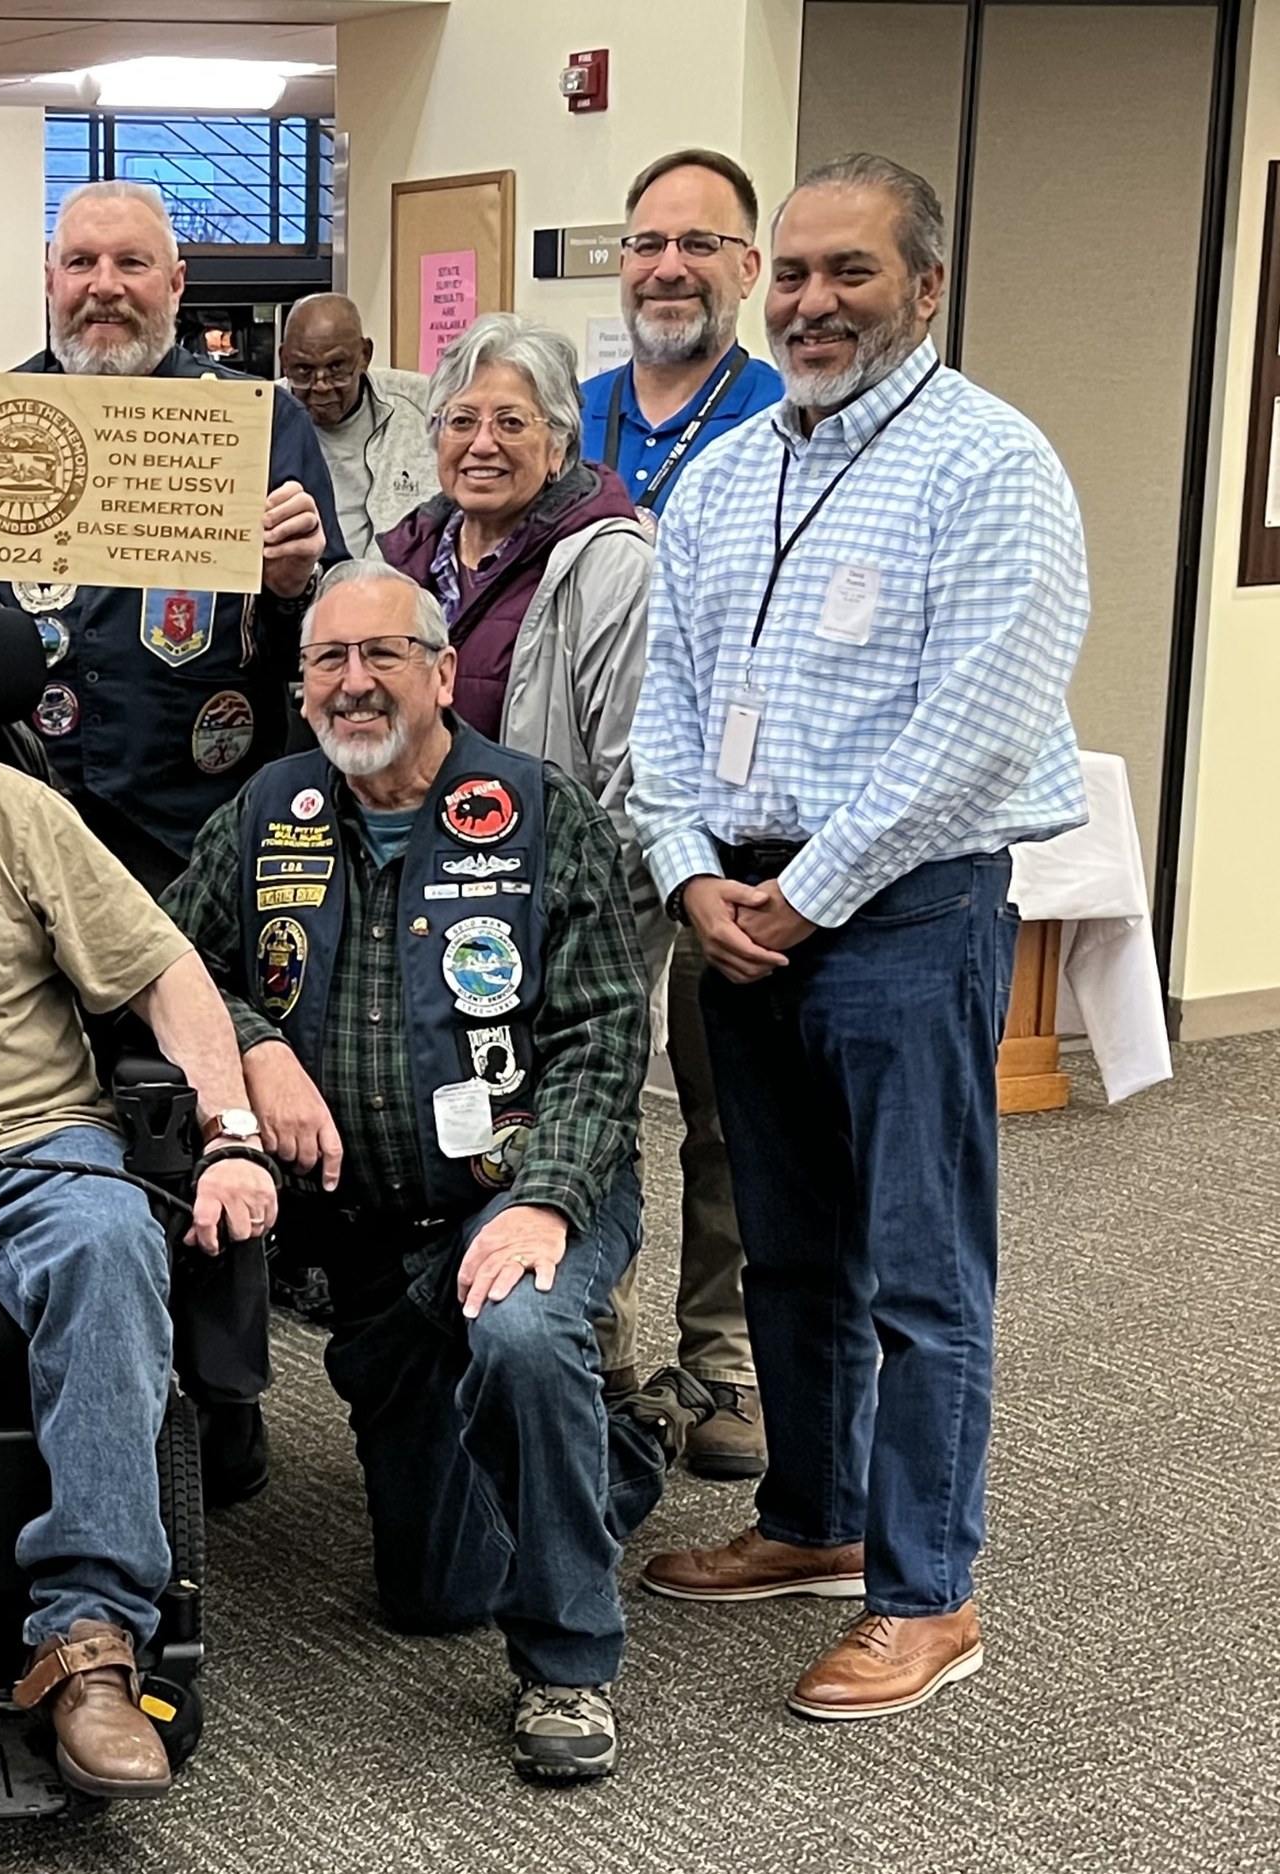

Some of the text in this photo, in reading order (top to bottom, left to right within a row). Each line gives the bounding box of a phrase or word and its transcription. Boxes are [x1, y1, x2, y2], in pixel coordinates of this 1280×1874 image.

[588, 249, 609, 265] 199
[438, 266, 460, 277] STATE
[433, 293, 464, 304] RESULTS
[442, 306, 455, 317] ARE
[429, 319, 467, 330] AVAILABLE
[102, 404, 234, 423] THIS KENNEL
[38, 403, 63, 424] THE
[62, 421, 85, 487] MEMORY
[94, 428, 240, 447] WAS DONATED
[108, 453, 223, 470] ON BEHALF
[92, 476, 235, 494] OF THE USSVI
[101, 500, 224, 516] BREMERTON
[76, 522, 251, 542] BASE SUBMARINE
[107, 546, 217, 564] VETERANS.
[444, 789, 472, 806] BULL
